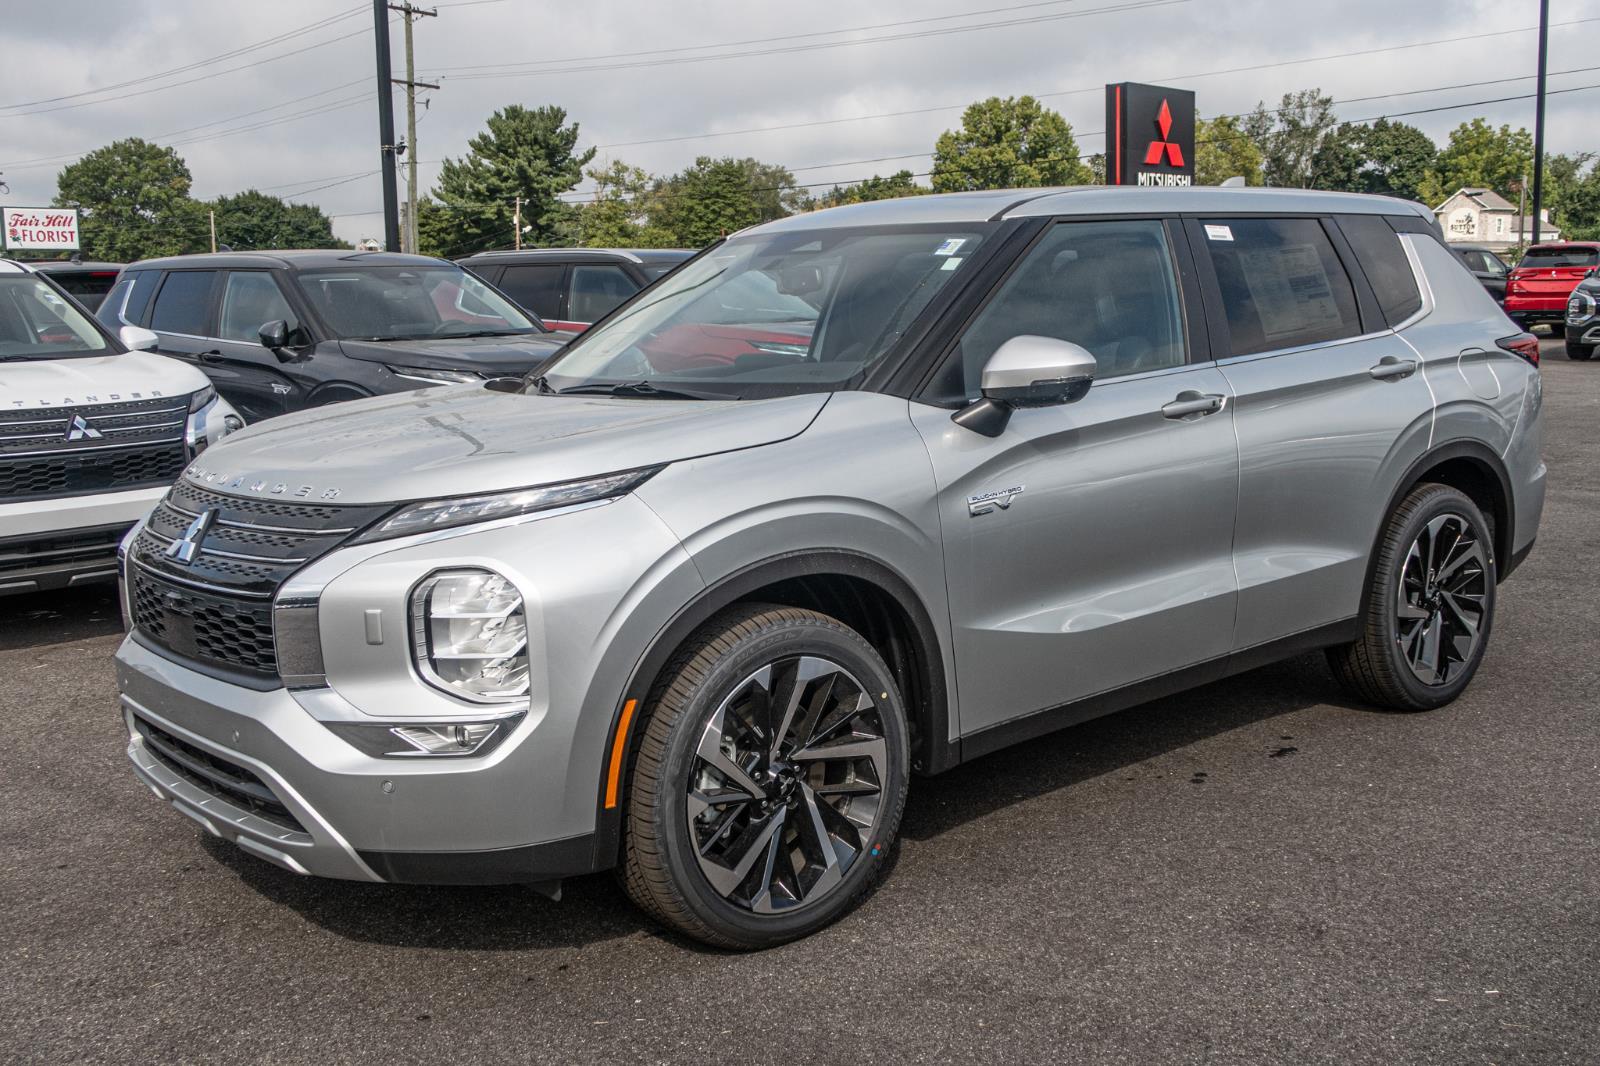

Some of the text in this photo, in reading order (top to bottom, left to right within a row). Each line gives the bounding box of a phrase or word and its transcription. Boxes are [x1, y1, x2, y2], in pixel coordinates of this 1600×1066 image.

[1138, 172, 1191, 187] MITSUBISHI
[9, 213, 74, 228] Fair Hill
[21, 229, 76, 243] FLORIST
[968, 495, 1016, 518] EV
